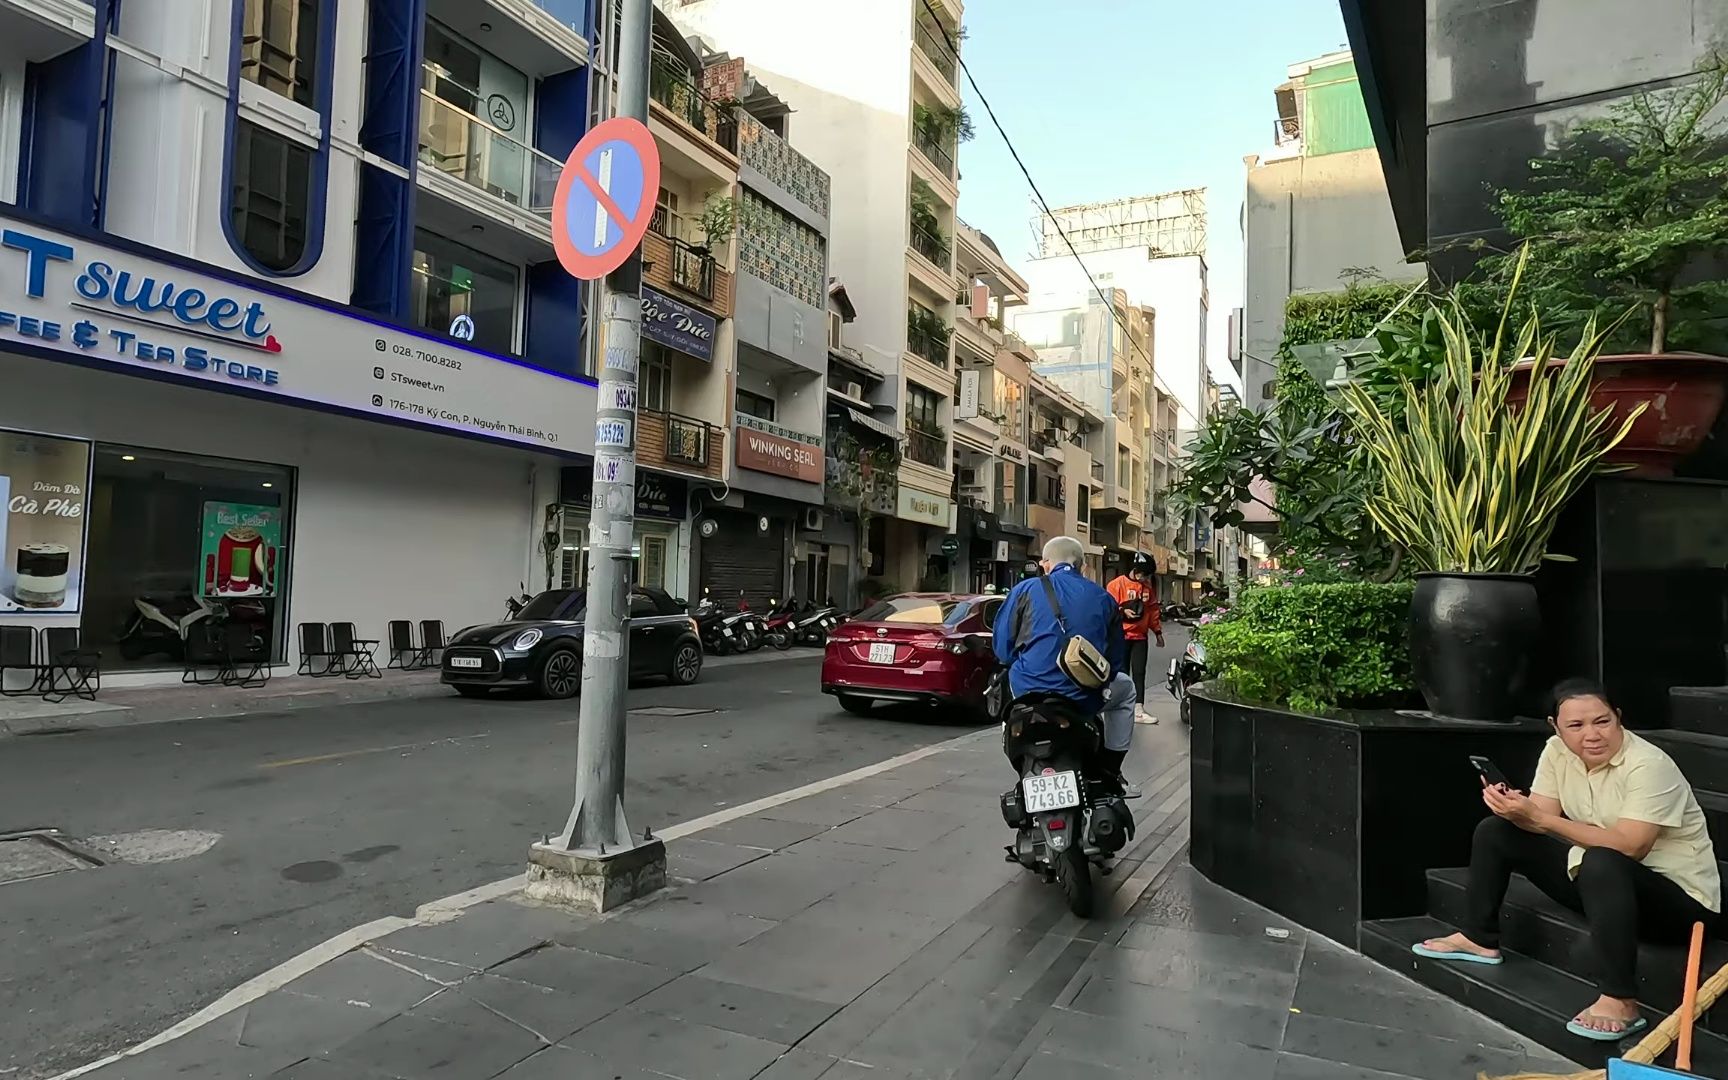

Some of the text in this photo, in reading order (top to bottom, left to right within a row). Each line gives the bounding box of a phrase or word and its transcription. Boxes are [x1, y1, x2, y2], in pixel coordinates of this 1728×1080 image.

[74, 261, 271, 340] sweet
[416, 350, 462, 371] 7100.8282
[390, 372, 445, 393] STsweet.vn
[389, 399, 424, 415] 176-178
[426, 407, 439, 420] Ký
[440, 409, 461, 424] Con,
[463, 415, 471, 425] P.
[508, 424, 525, 436] Thái
[749, 436, 791, 461] WINKING
[794, 448, 815, 466] SEAL
[8, 495, 81, 518] Cà Phê
[1031, 775, 1068, 793] 59-K2
[1030, 790, 1074, 809] 743.66
